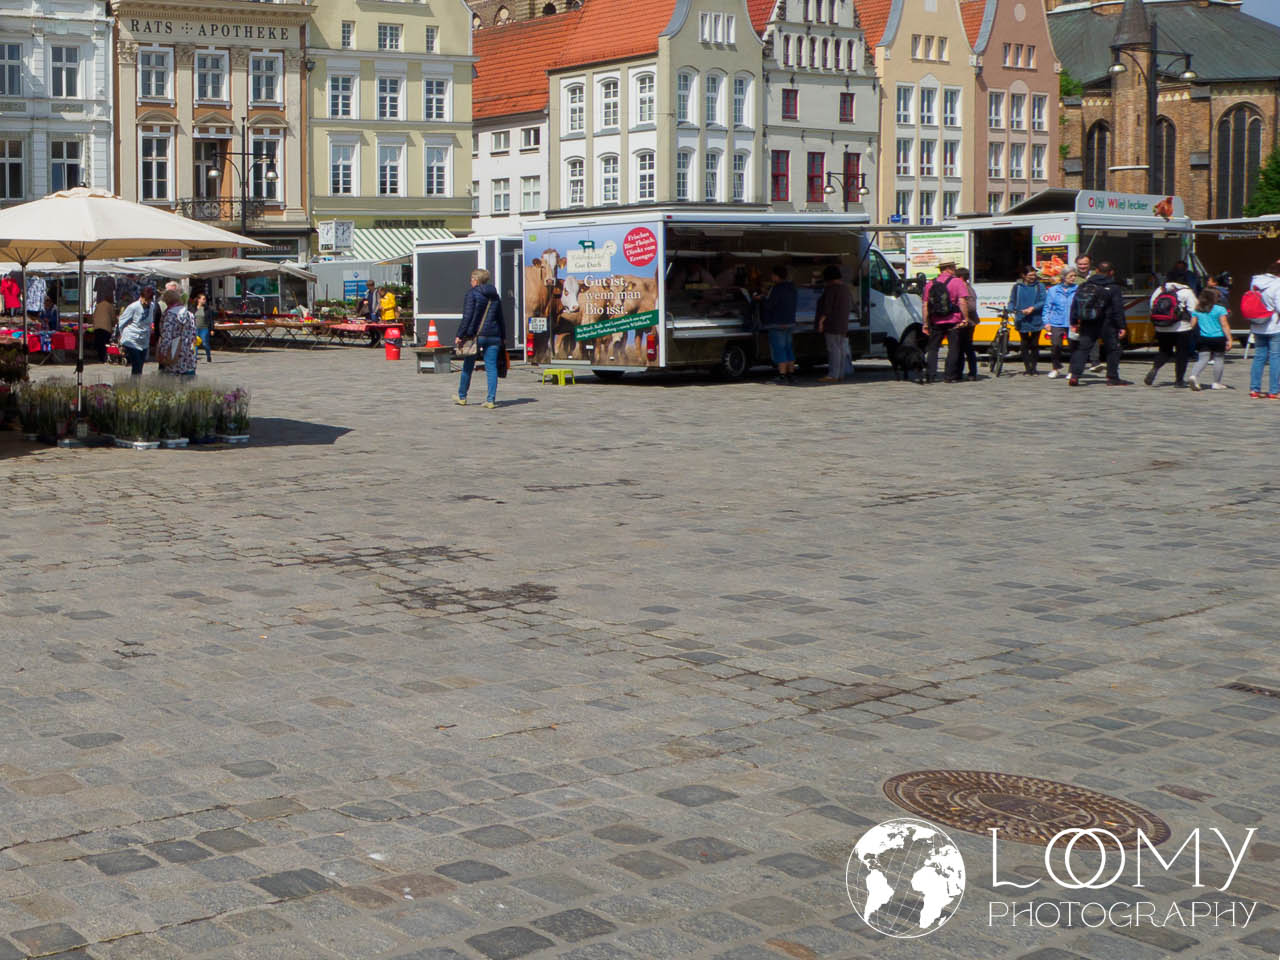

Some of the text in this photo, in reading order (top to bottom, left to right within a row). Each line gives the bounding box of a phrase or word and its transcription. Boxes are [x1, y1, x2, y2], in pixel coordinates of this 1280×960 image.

[130, 19, 289, 40] RATS APOTHEKE
[1042, 232, 1061, 242] OWI
[584, 274, 629, 289] Gut ist,
[585, 290, 641, 300] wenn man
[585, 302, 629, 315] Bio isst.
